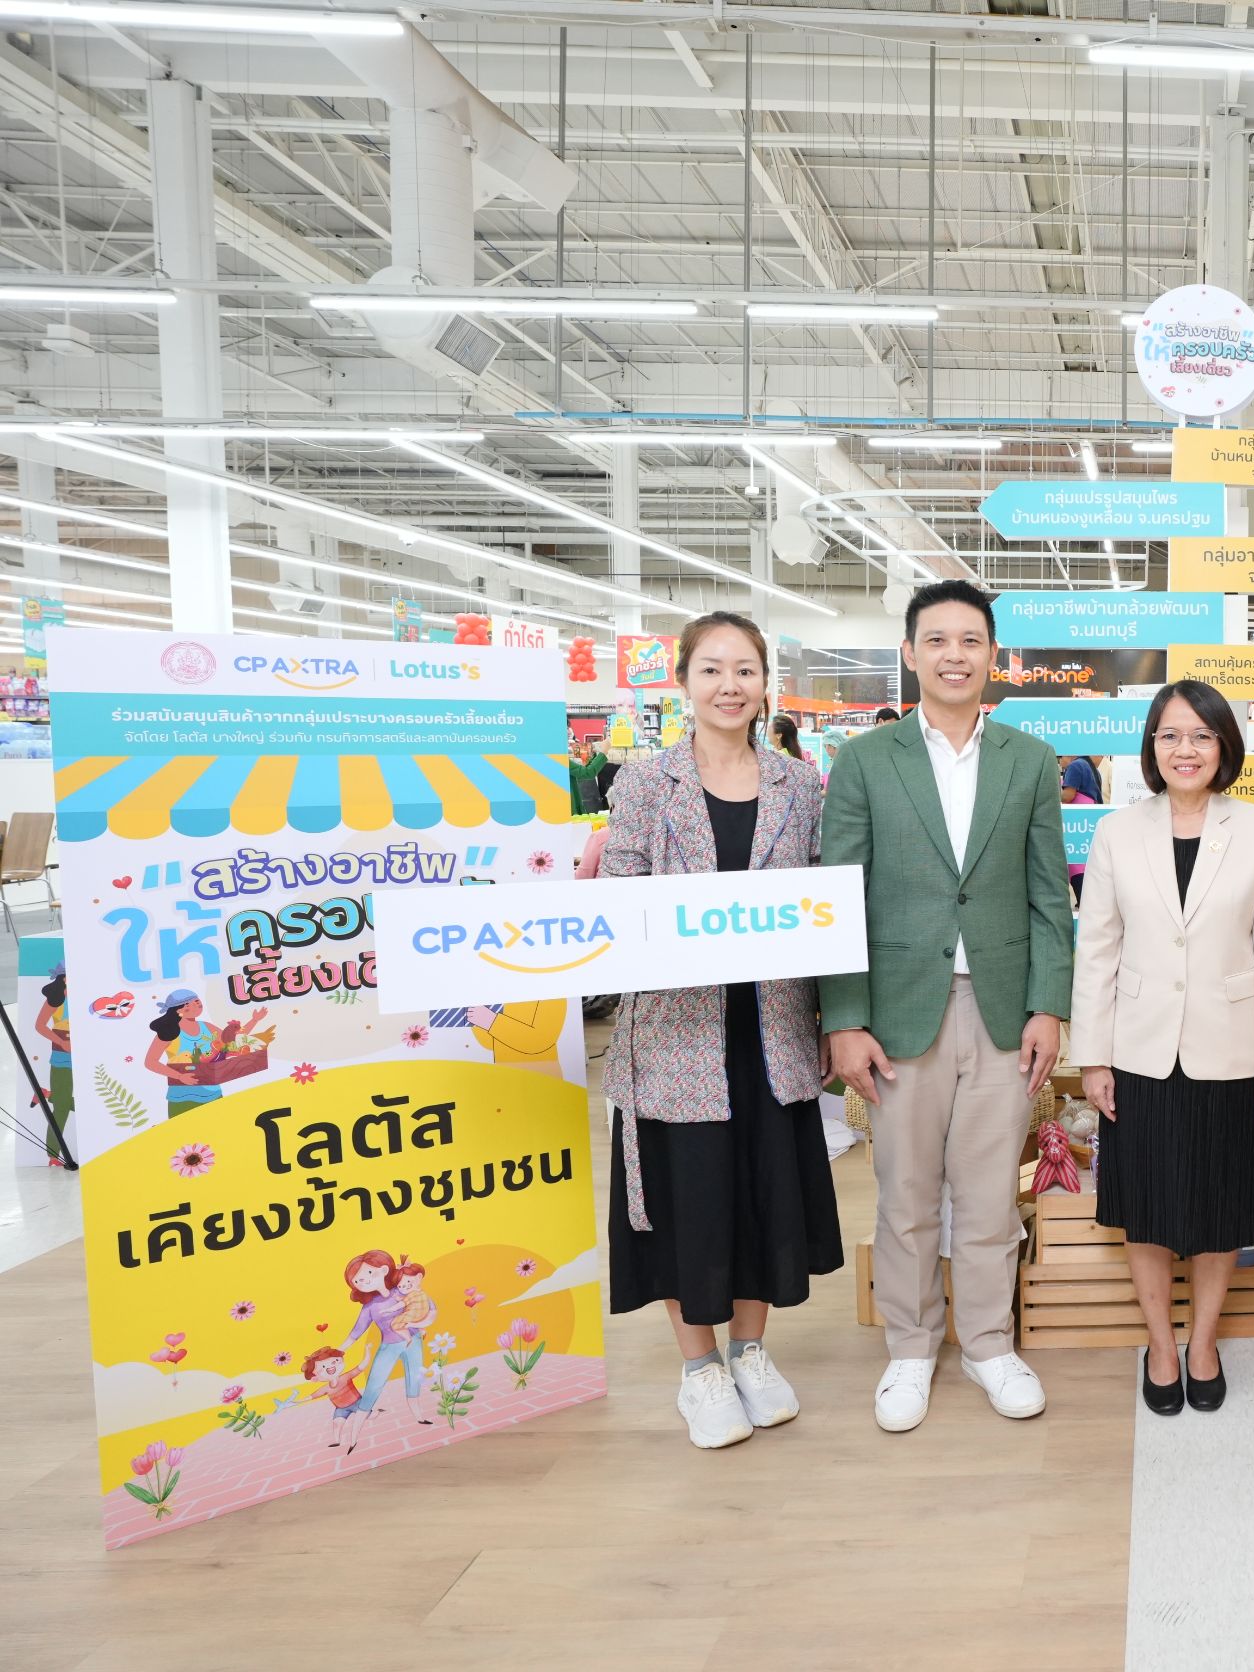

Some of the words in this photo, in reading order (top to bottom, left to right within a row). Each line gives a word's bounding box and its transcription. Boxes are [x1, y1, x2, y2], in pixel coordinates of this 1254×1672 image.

[1170, 355, 1233, 376] เลี้ยงเดี่ยว
[1045, 489, 1178, 509] กลุ่มแปรรูปสมุนไพร
[1012, 508, 1132, 528] บ้านหนองงูเหลือม
[1138, 510, 1210, 528] จ.นครปฐม
[1012, 599, 1209, 621] กลุ่มอาชีพบ้านกล้วยพัฒนา
[1069, 621, 1137, 640] จ.นนทบุรี
[234, 656, 267, 673] CP
[271, 657, 360, 675] AXTRA
[390, 659, 481, 680] Lotus's
[990, 666, 1090, 683] BeePhone
[111, 706, 524, 726] ร่วมสนับสนุนสินค้าจากกลุ่มเปราะบางครอบครัวเลี้ยงเดี่ยว
[124, 730, 168, 743] จัดโดย
[173, 731, 208, 743] โลตัส
[213, 731, 264, 744] บางใหญ่
[269, 731, 312, 744] ร่วมกับ
[317, 731, 516, 744] กรมกิจการสตรีและสถาบันครอบครัว
[412, 925, 467, 955] CP
[473, 915, 615, 952] AXTRA
[676, 898, 834, 937] Lotus's
[102, 901, 221, 983] ให้
[255, 1094, 456, 1175] โลตัส
[117, 1148, 573, 1268] เคียงข้างชุมชน
